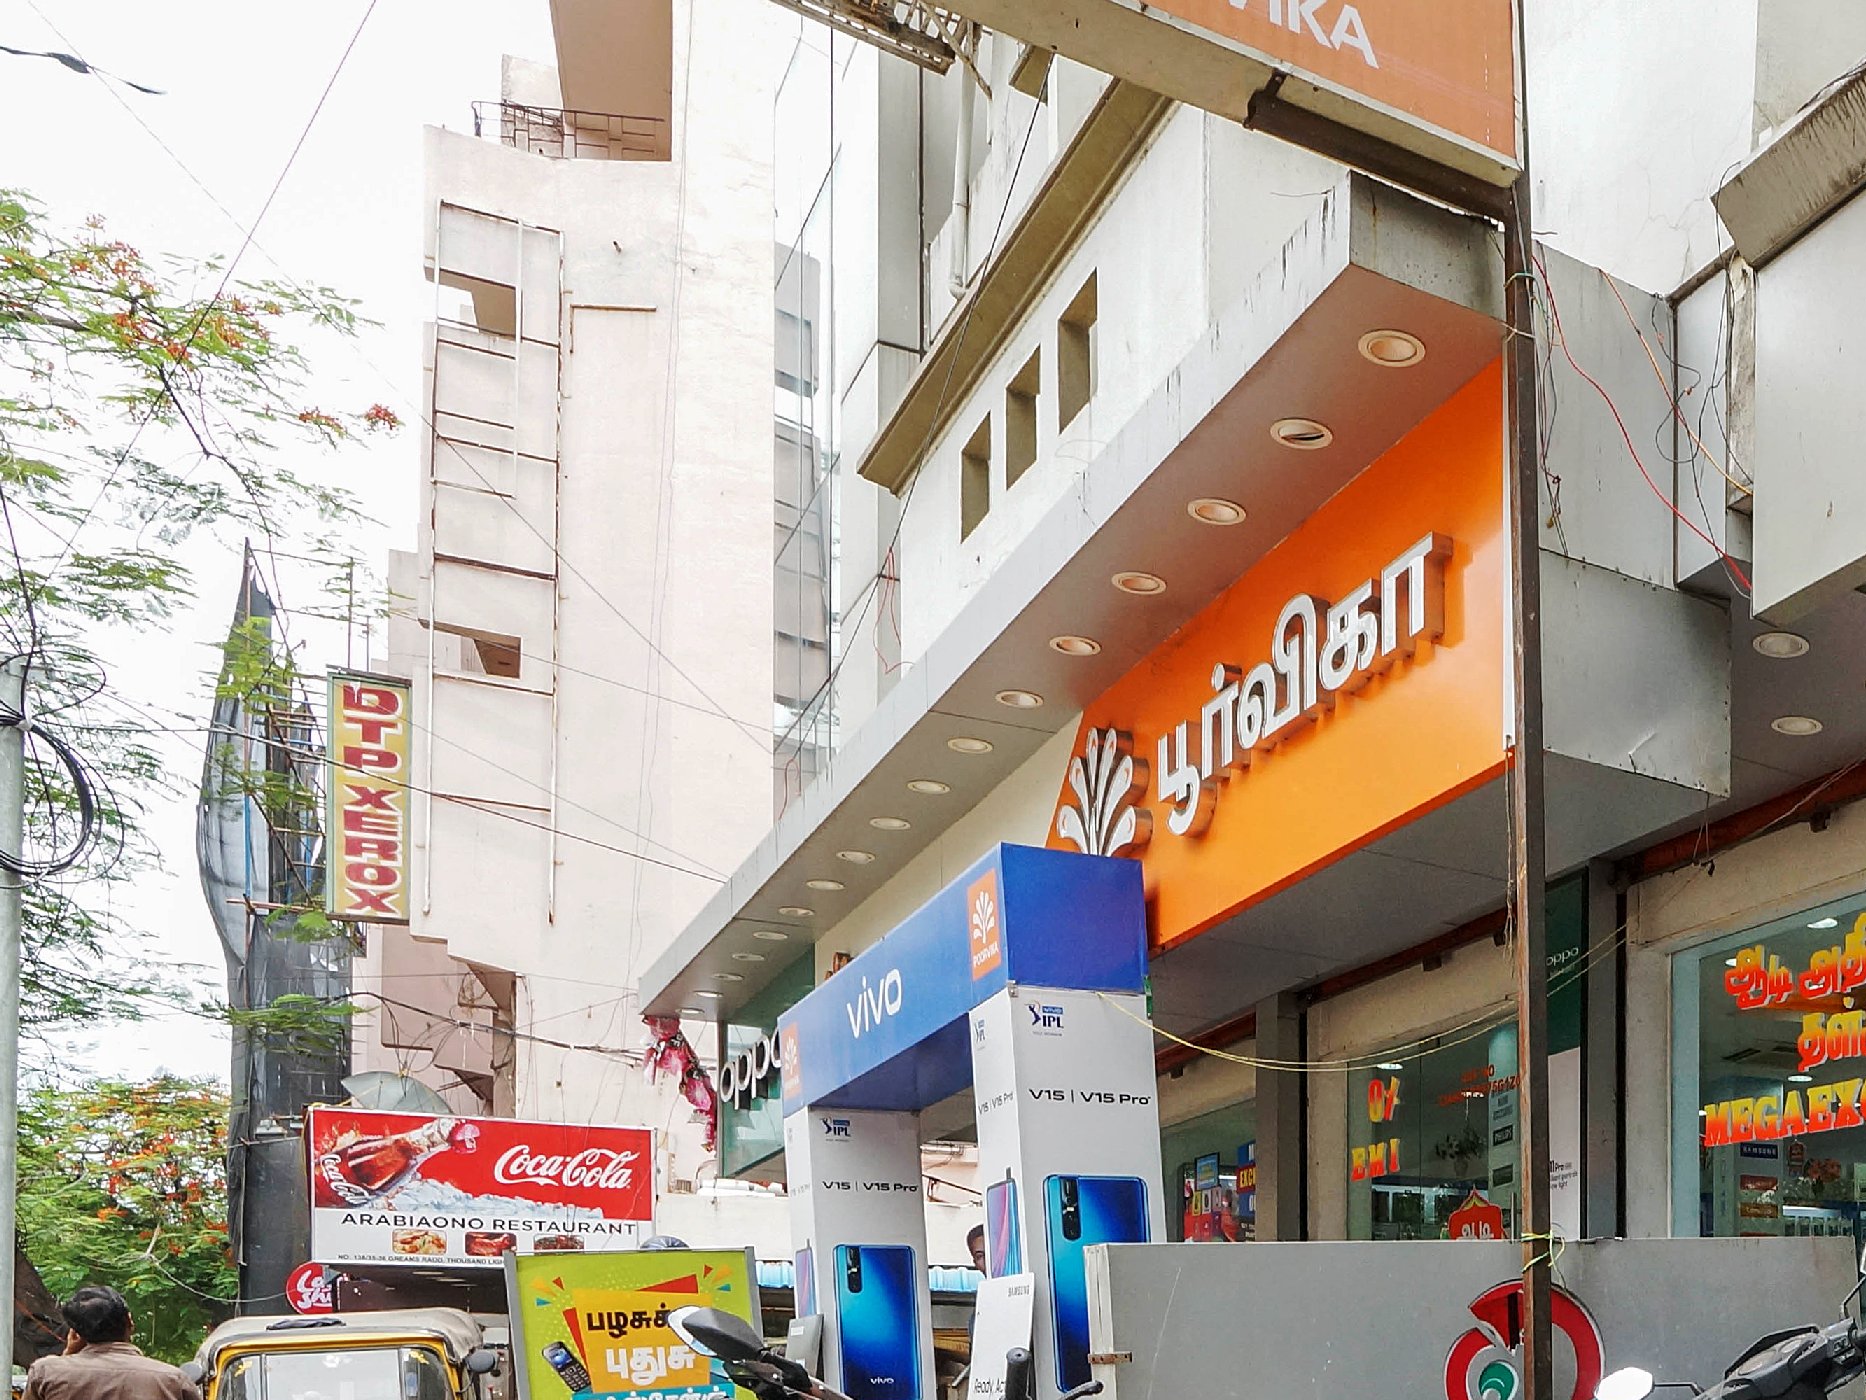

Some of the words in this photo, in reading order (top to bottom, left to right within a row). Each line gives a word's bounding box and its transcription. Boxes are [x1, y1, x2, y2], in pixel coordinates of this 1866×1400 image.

[1229, 0, 1379, 69] IKA
[1157, 531, 1437, 837] பூர்விகா
[342, 684, 402, 777] DTP
[343, 783, 402, 917] XEROX
[1545, 946, 1579, 967] oppo
[846, 968, 902, 1038] vivo
[1042, 1015, 1064, 1028] IPL
[1029, 1088, 1064, 1101] V15
[1080, 1091, 1115, 1104] V15
[1119, 1094, 1151, 1105] Pro
[833, 1126, 851, 1137] IPL
[822, 1181, 851, 1190] V15
[863, 1182, 890, 1192] V15
[893, 1183, 918, 1193] Pro
[341, 1212, 484, 1231] ARABIAONO
[492, 1217, 638, 1236] RESTAURANT
[586, 1302, 671, 1338] பழசுக்
[870, 1376, 895, 1385] vivo
